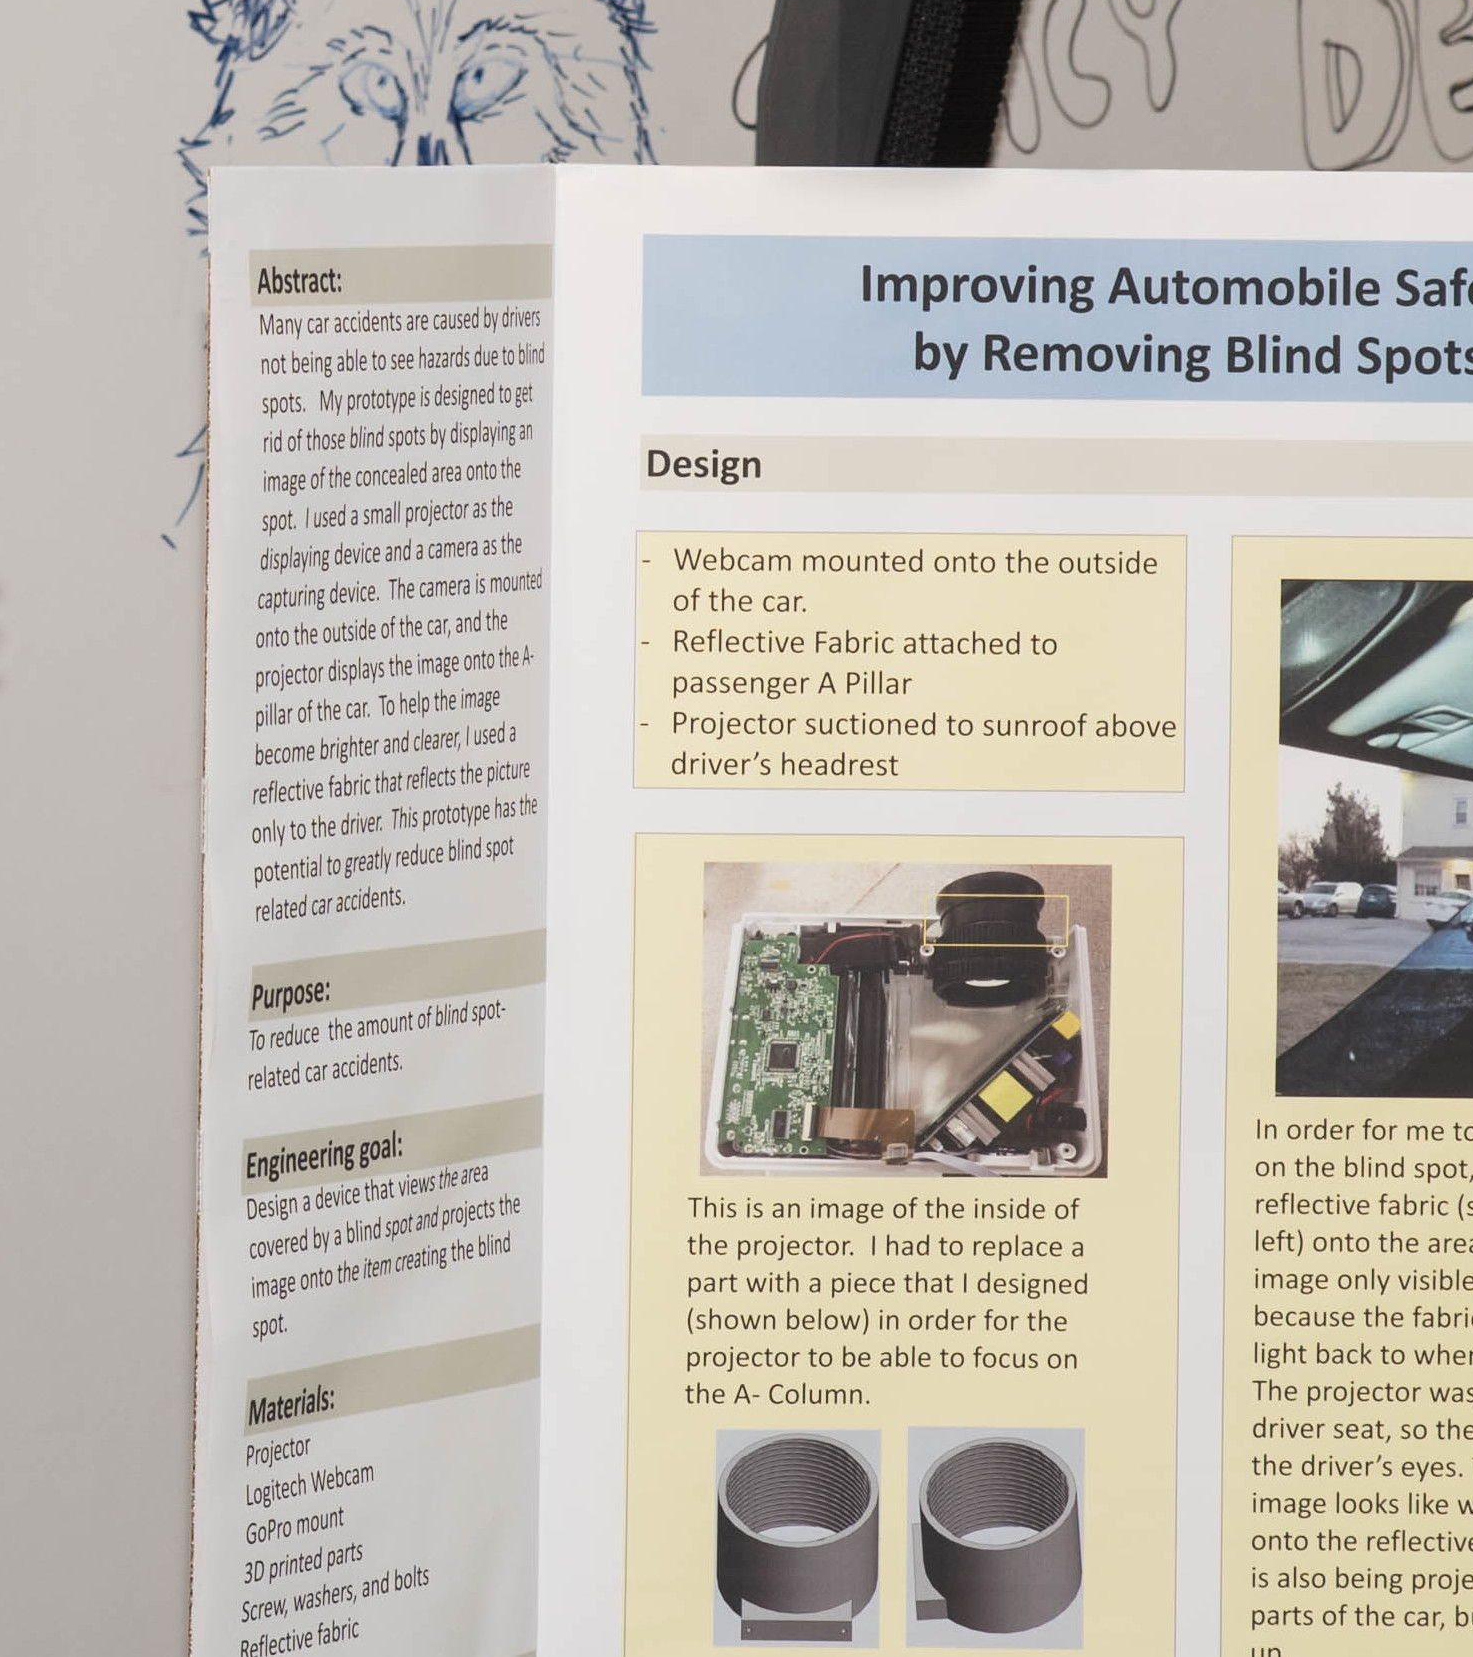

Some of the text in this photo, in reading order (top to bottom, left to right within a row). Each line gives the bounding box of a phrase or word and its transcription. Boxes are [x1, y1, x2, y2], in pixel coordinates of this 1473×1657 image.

[257, 265, 342, 295] Abstract:
[862, 264, 1095, 314] Improving
[1107, 265, 1381, 307] Automobile
[259, 305, 541, 341] Many car accidents are caused by drivers
[914, 330, 969, 381] by
[984, 333, 1212, 383] Removing
[1227, 333, 1341, 375] Blind
[647, 448, 762, 486] Design
[673, 546, 1158, 575] Webcam mounted onto the outside
[673, 587, 807, 613] of the car.
[673, 628, 1058, 656] Reflective Fabric attached to
[673, 669, 913, 700] passenger A Pillar
[672, 711, 1177, 741] Projector suctioned to sunroof above
[781, 751, 899, 777] headrest
[255, 885, 406, 923] related car accidents.
[251, 981, 330, 1014] Purpose:
[248, 999, 507, 1052] To reduce the amount of blind spot-
[248, 1051, 403, 1091] related car accidents.
[1256, 1118, 1278, 1140] In
[1286, 1117, 1355, 1141] order
[1361, 1117, 1399, 1141] for
[1406, 1124, 1445, 1142] me
[246, 1129, 403, 1183] Engineering goal:
[246, 1164, 489, 1222] Design a device that views the area
[687, 1195, 1081, 1225] This is an image of the inside of
[248, 1383, 335, 1427] Materials:
[684, 1381, 726, 1405] the
[768, 1382, 871, 1405] Column.
[246, 1437, 311, 1469] Projector
[246, 1465, 374, 1509] Logitech Webcam
[245, 1506, 345, 1545] GoPro mount
[244, 1542, 364, 1585] 3D printed parts
[241, 1564, 430, 1624] Screw, washers, and bolts
[240, 1616, 360, 1657] Reflective fabric
